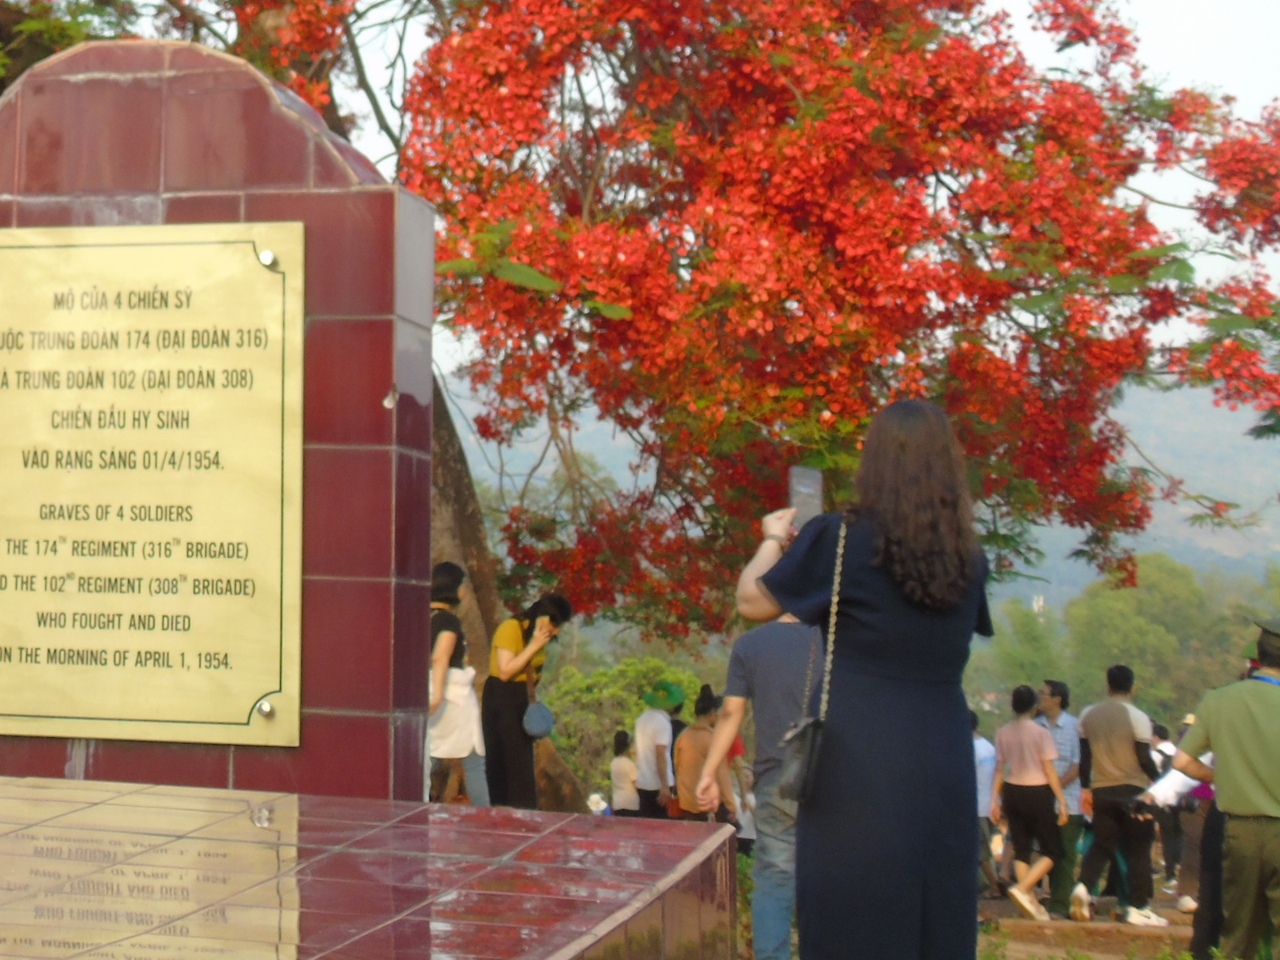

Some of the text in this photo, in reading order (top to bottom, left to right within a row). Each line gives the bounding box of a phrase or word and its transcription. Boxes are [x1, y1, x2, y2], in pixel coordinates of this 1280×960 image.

[81, 285, 108, 310] CỦA
[113, 291, 123, 310] 4
[127, 284, 169, 310] CHIẾN
[30, 331, 75, 351] TRUNG
[81, 327, 119, 351] ĐOÀN
[127, 329, 150, 350] 174
[156, 329, 185, 353] (ĐẠI
[191, 325, 230, 349] ĐOÀN
[236, 328, 268, 350] 316)
[15, 370, 61, 390] TRUNG
[66, 367, 105, 390] ĐOÀN
[112, 370, 136, 390] 102
[141, 370, 171, 393] (ĐẠI
[176, 366, 215, 390] ĐOÀN
[222, 369, 253, 391] 308)
[51, 404, 189, 430] CHIẾN ĐẤU HY SINH
[22, 446, 224, 473] VÀO RẠNG SÁNG 01/4/1954.
[39, 503, 193, 522] GRAVES OF 4 SOLDIERS
[6, 538, 28, 556] THE
[72, 539, 137, 558] REGIMENT
[186, 541, 249, 561] BRIGADE)
[13, 574, 36, 592] THE
[78, 576, 143, 594] REGIMENT
[193, 578, 256, 598] BRIGADE)
[36, 611, 191, 632] WHO FOUGHT AND DIED
[17, 646, 41, 664] THE
[46, 648, 108, 667] MORNING
[113, 649, 129, 667] OF
[135, 650, 173, 669] APRIL
[180, 652, 190, 671] 1,
[197, 652, 232, 670] 1954.
